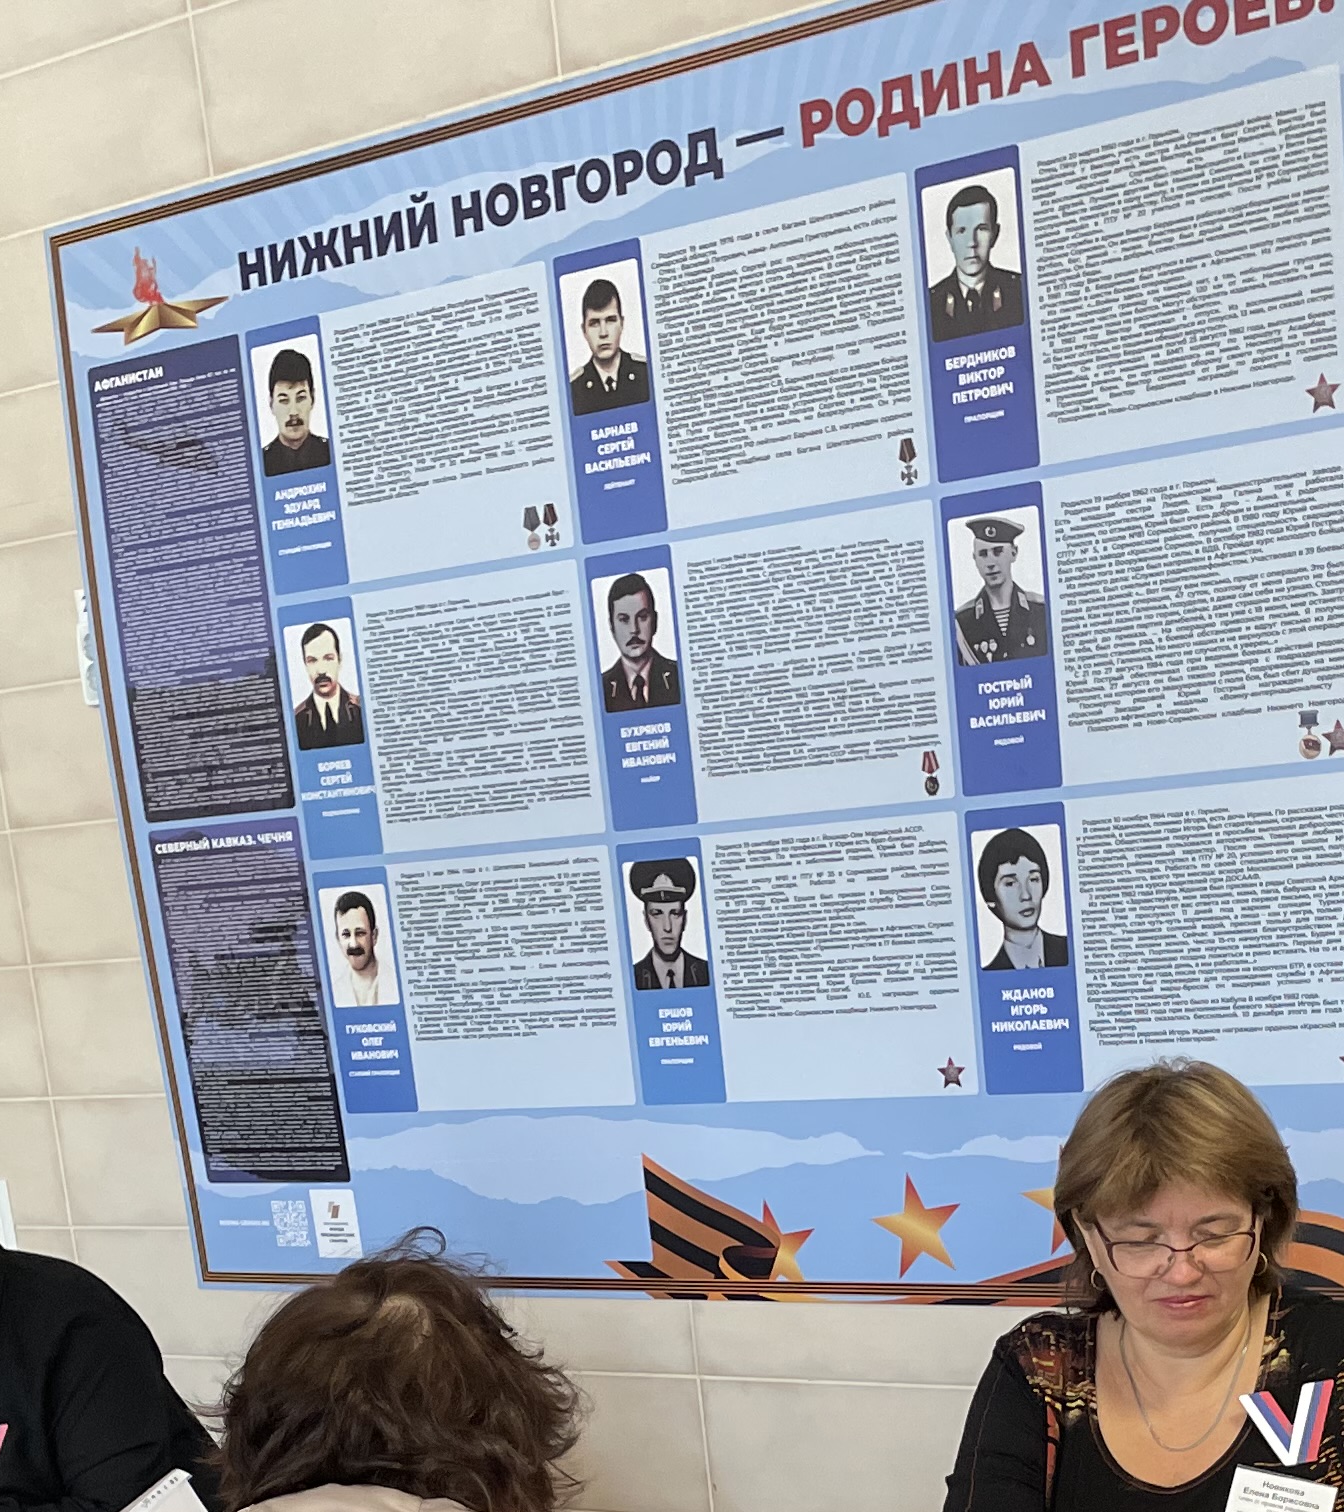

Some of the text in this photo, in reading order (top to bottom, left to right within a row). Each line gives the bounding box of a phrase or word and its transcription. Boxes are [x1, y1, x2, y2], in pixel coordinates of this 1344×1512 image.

[238, 191, 438, 291] НИЖНИЙ
[451, 127, 725, 238] НОВГОРОД
[799, 41, 1052, 149] РОДИНА
[945, 345, 1016, 371] БЕРДНИКОВ
[94, 366, 164, 392] АФГАНИСТАН
[958, 366, 1005, 386] ВИКТОР
[952, 381, 1014, 404] ПЕТРОВИЧ
[591, 421, 639, 441] БАРНАЕВ
[597, 436, 635, 455] СЕРГЕЙ
[585, 451, 651, 474] ВАСИЛЬЕВИЧ
[284, 498, 321, 514] ЭДУАРД
[272, 510, 336, 531] ГЕННАДЬЕВИЧ
[978, 674, 1032, 695] ГОСТРЫЙ
[989, 692, 1024, 710] ЮРИЙ
[970, 709, 1046, 729] ВАСИЛЬЕВИЧ
[625, 735, 670, 752] ЕВГЕНИЙ
[621, 752, 676, 768] ИВАНОВИЧ
[320, 771, 353, 786] СЕРГЕЙ
[155, 831, 293, 854] СЕВЕРНЫЙ КАВКАЗ. ЧЕЧНЯ
[1001, 987, 1055, 1002] ЖДАНОВ
[658, 1007, 693, 1019] ЕРШОВ
[1011, 1003, 1048, 1016] ИГОРЬ
[662, 1019, 692, 1032] ЮРИЙ
[991, 1018, 1069, 1032] НИКОЛАЕВИЧ
[361, 1037, 384, 1047] ОЛЕГ
[649, 1035, 709, 1047] ЕВГЕНЬЕВИЧ
[351, 1049, 399, 1060] ИВАНОВИЧ
